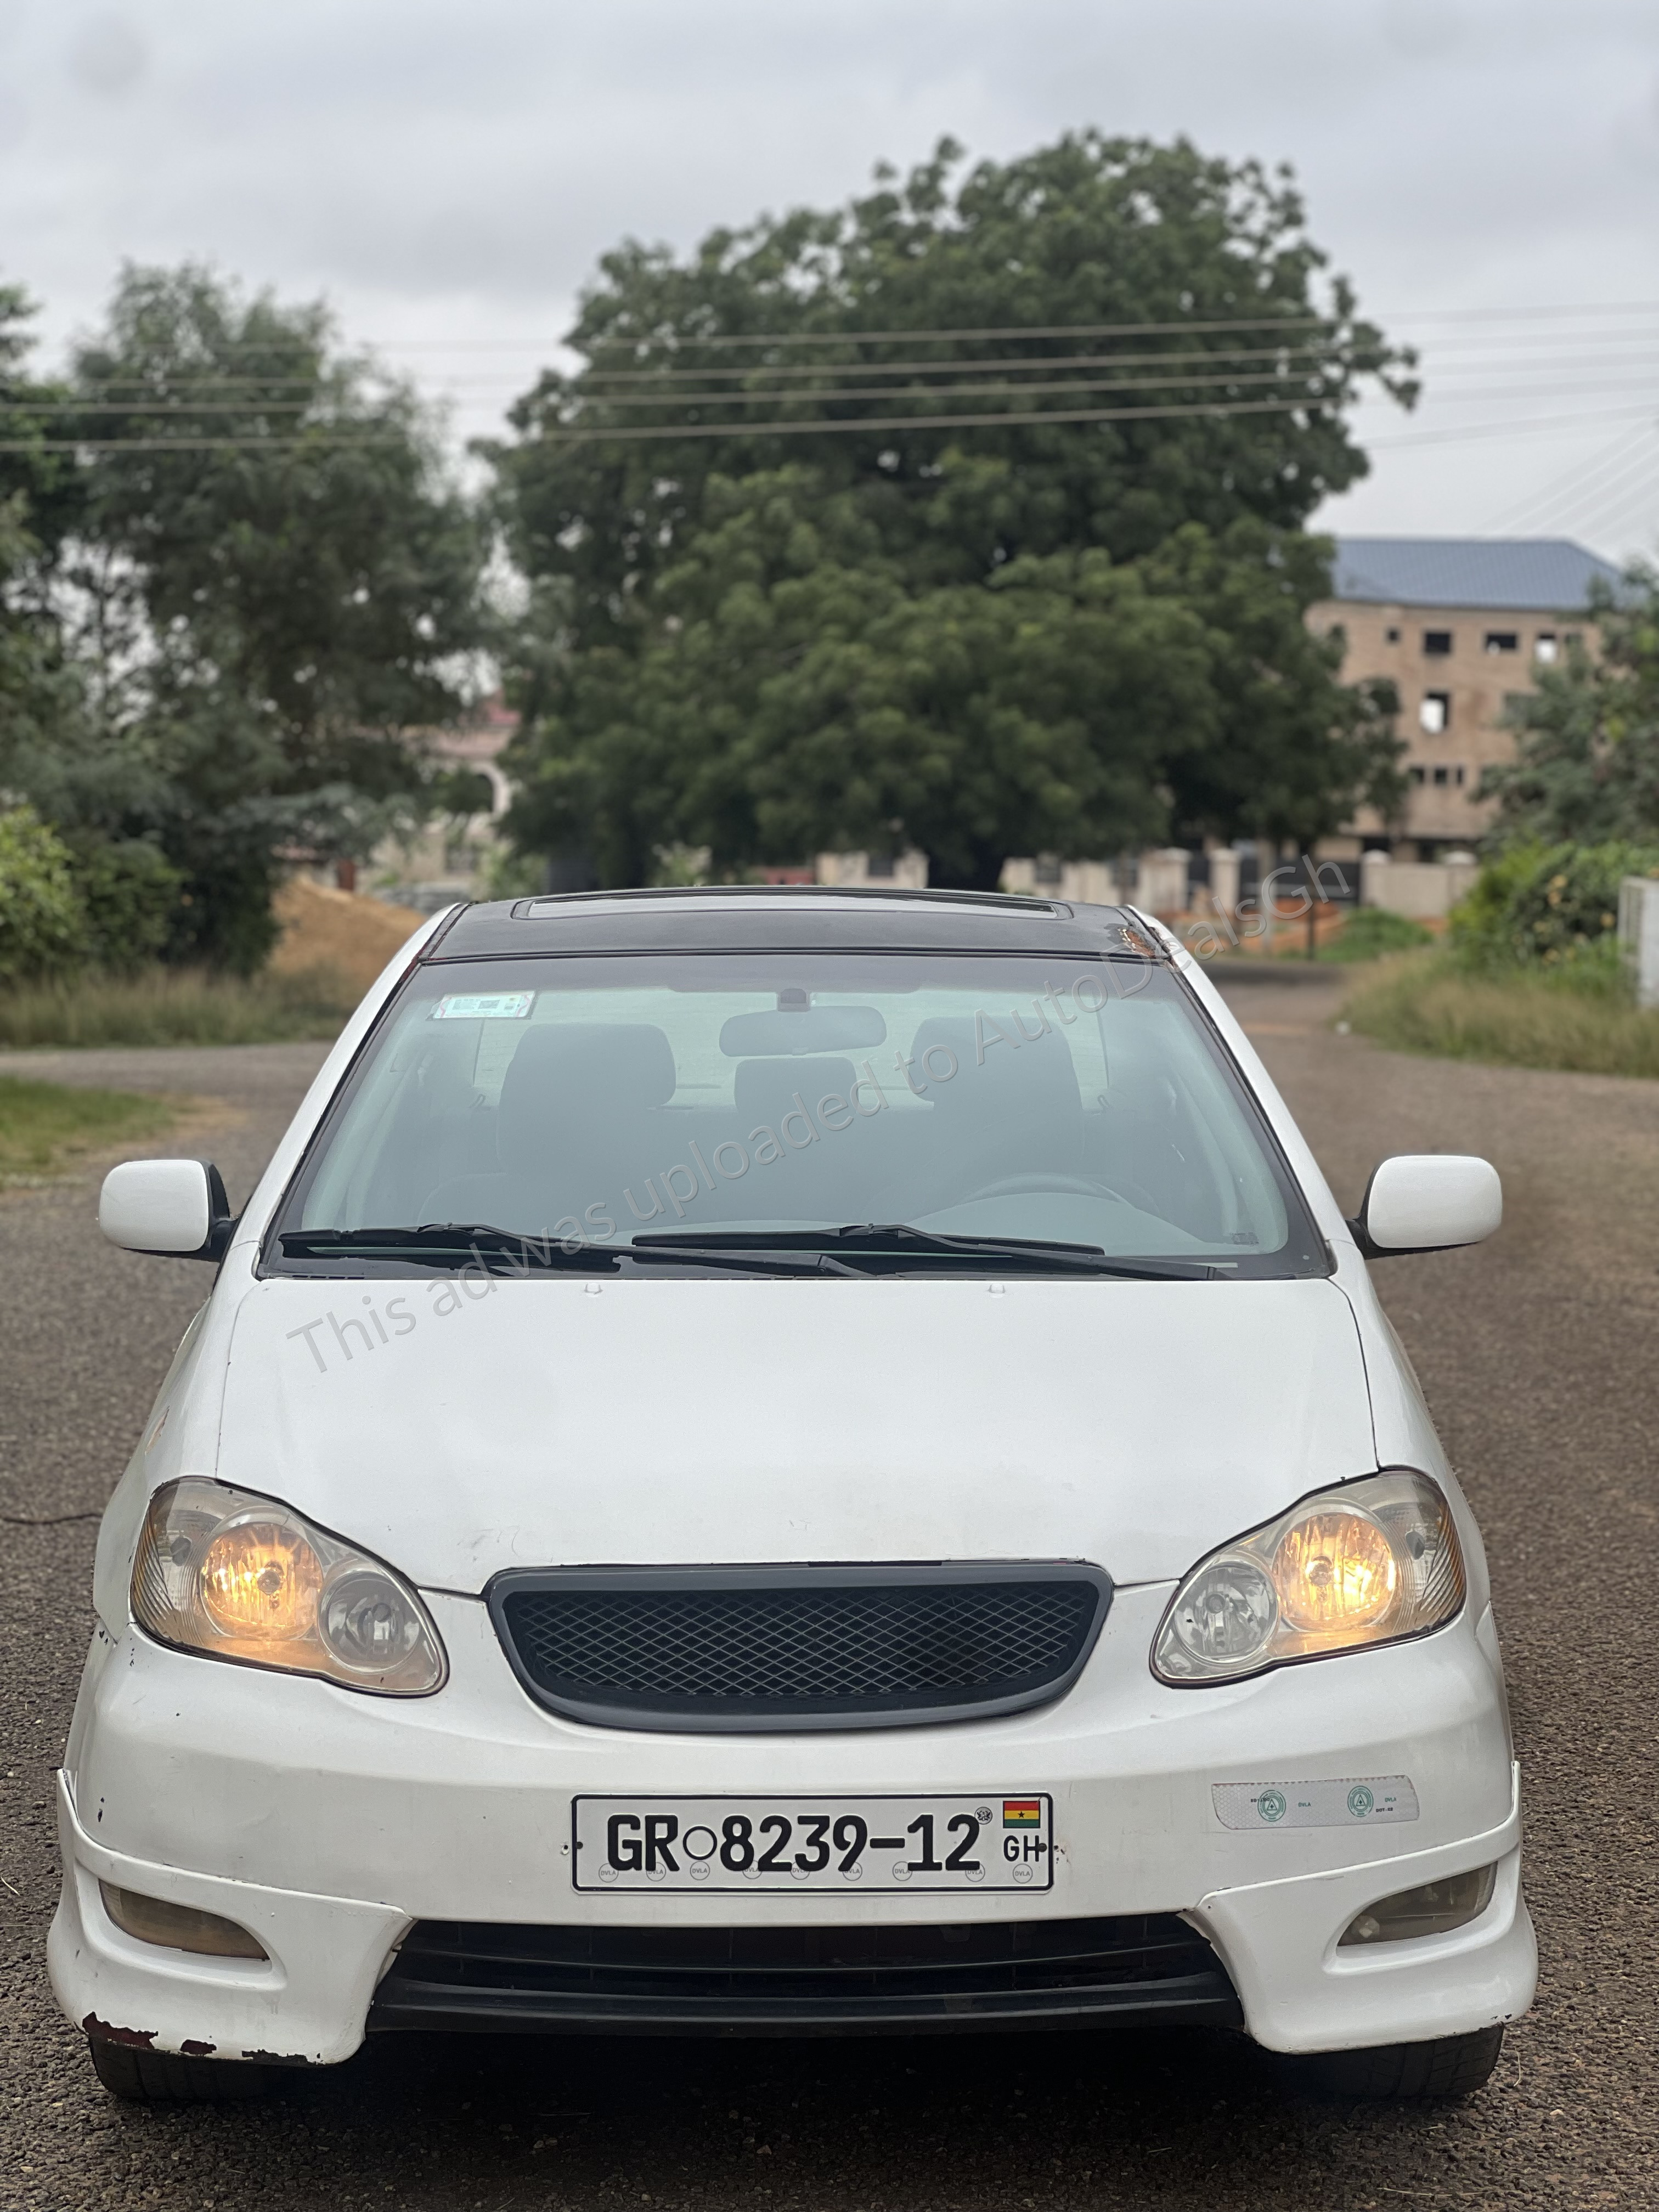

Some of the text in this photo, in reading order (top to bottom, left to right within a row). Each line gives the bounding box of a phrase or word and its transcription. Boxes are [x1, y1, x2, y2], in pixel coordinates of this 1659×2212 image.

[607, 1814, 980, 1871] GR 8239-12
[1003, 1835, 1040, 1862] GH
